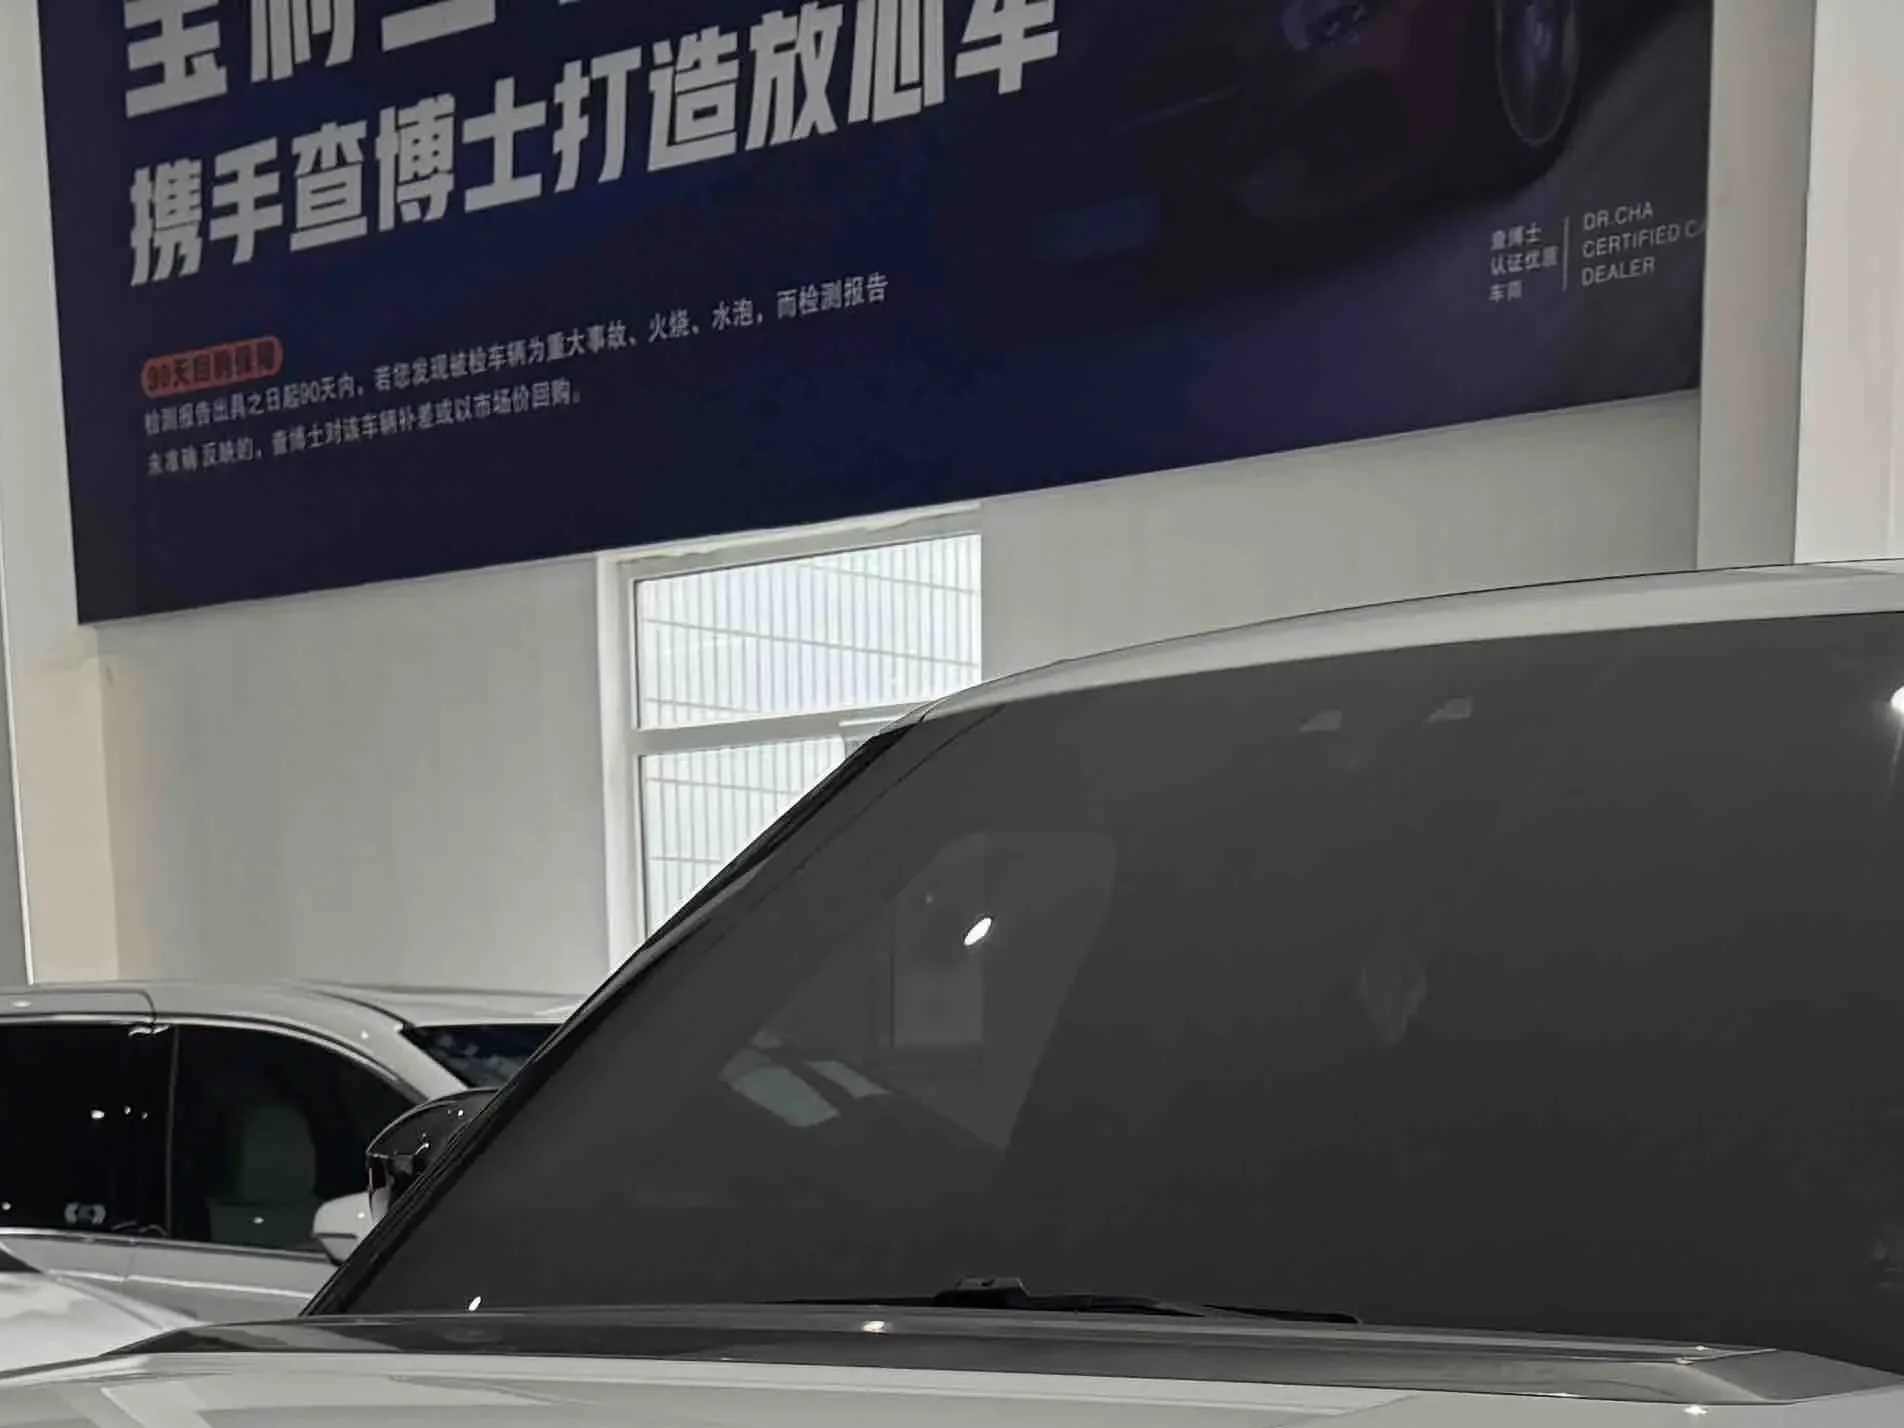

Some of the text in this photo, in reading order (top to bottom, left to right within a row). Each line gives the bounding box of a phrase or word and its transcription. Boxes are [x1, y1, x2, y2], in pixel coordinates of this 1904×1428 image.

[129, 0, 1062, 288] 携手查博士打造放心车
[1582, 223, 1682, 259] CERTIFIED
[1581, 256, 1656, 287] DEALER
